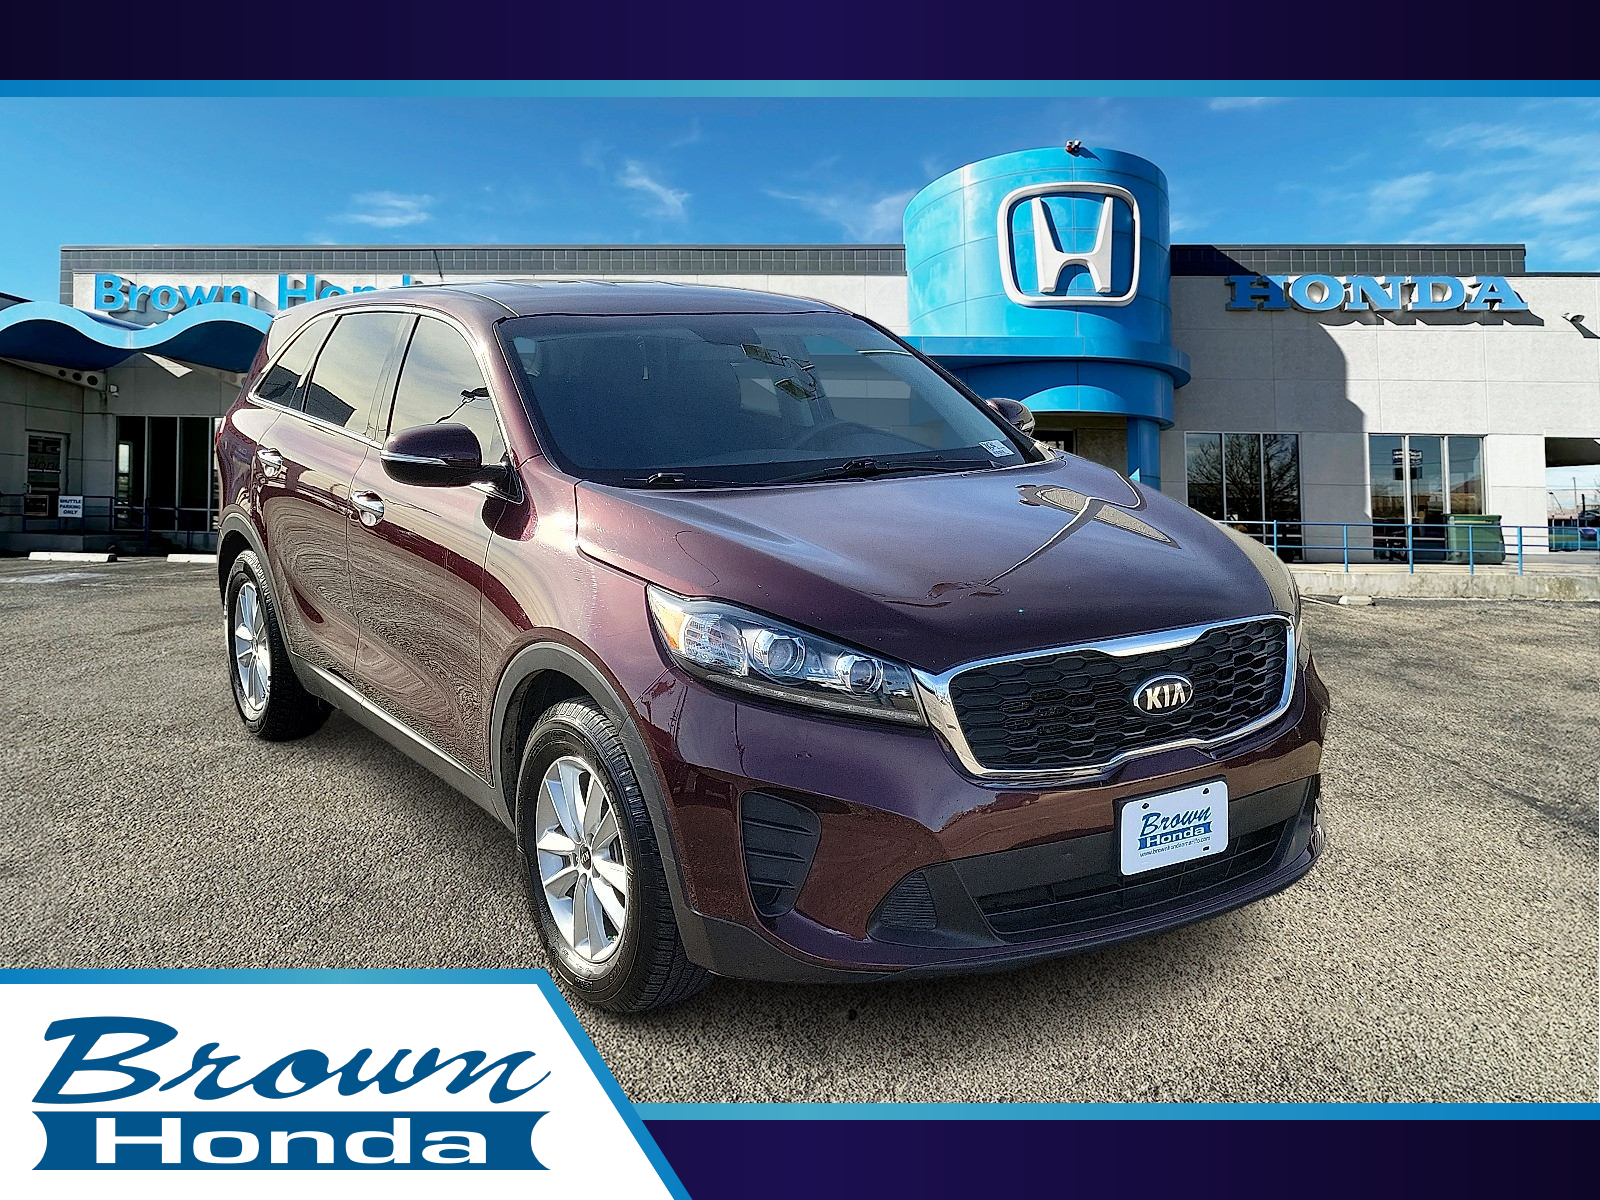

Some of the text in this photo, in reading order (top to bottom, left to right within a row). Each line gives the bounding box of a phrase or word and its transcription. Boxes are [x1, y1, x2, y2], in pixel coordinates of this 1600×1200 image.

[94, 273, 251, 312] Brown
[1225, 274, 1530, 312] HONDA
[1144, 682, 1186, 711] KIA
[1139, 806, 1212, 838] Brown
[1146, 826, 1205, 848] Honda
